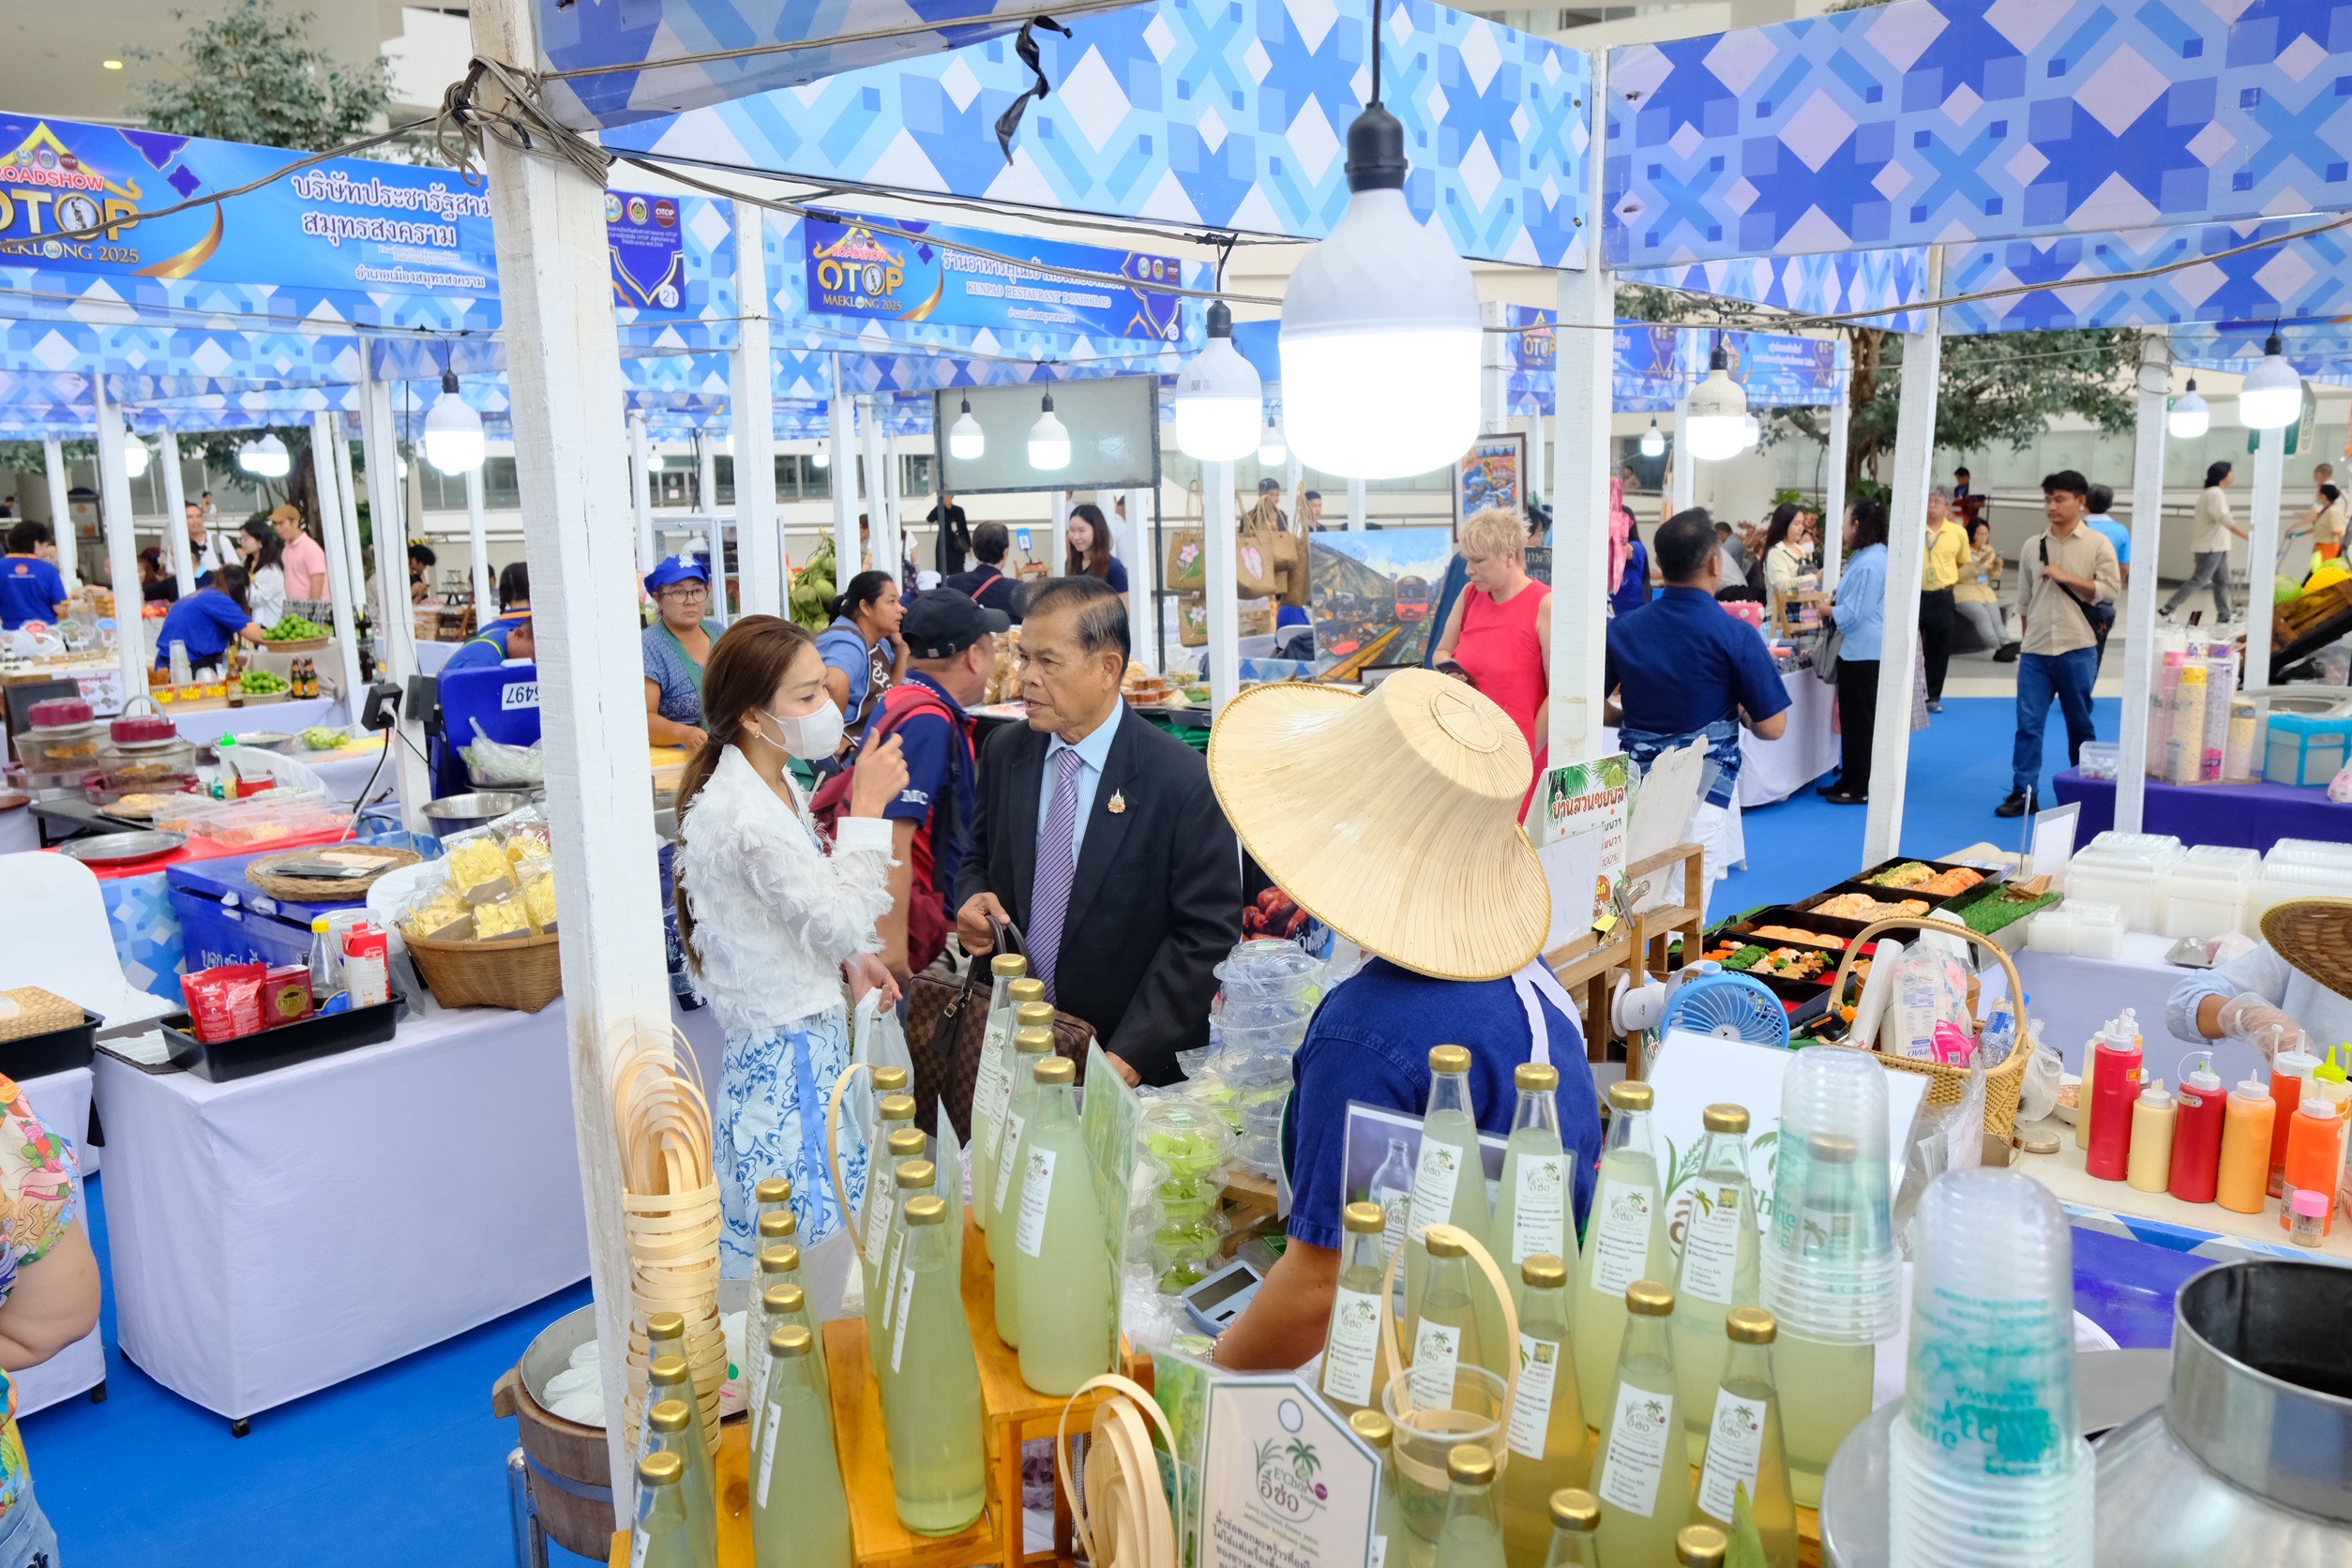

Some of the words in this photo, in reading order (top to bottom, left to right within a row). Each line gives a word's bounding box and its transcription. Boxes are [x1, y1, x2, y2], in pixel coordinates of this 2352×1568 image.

[293, 170, 490, 220] บริษัทประชารัฐสาม
[0, 188, 141, 242] TOP
[302, 212, 457, 247] สมุทรสงคราม
[97, 246, 140, 264] 2025
[832, 246, 887, 262] ROADSHOW
[355, 264, 486, 289] อำเภอเมืองสมุทรสงคราม
[817, 259, 904, 296] OTOP
[662, 290, 675, 304] 21
[823, 294, 880, 309] MAEKLONG
[882, 299, 902, 311] 2025
[967, 281, 1003, 297] KUNPAO
[1005, 285, 1062, 303] RESTAURANT
[1552, 786, 1624, 821] บ้านสวนชยพล
[1260, 1473, 1299, 1513] อีช่อ
